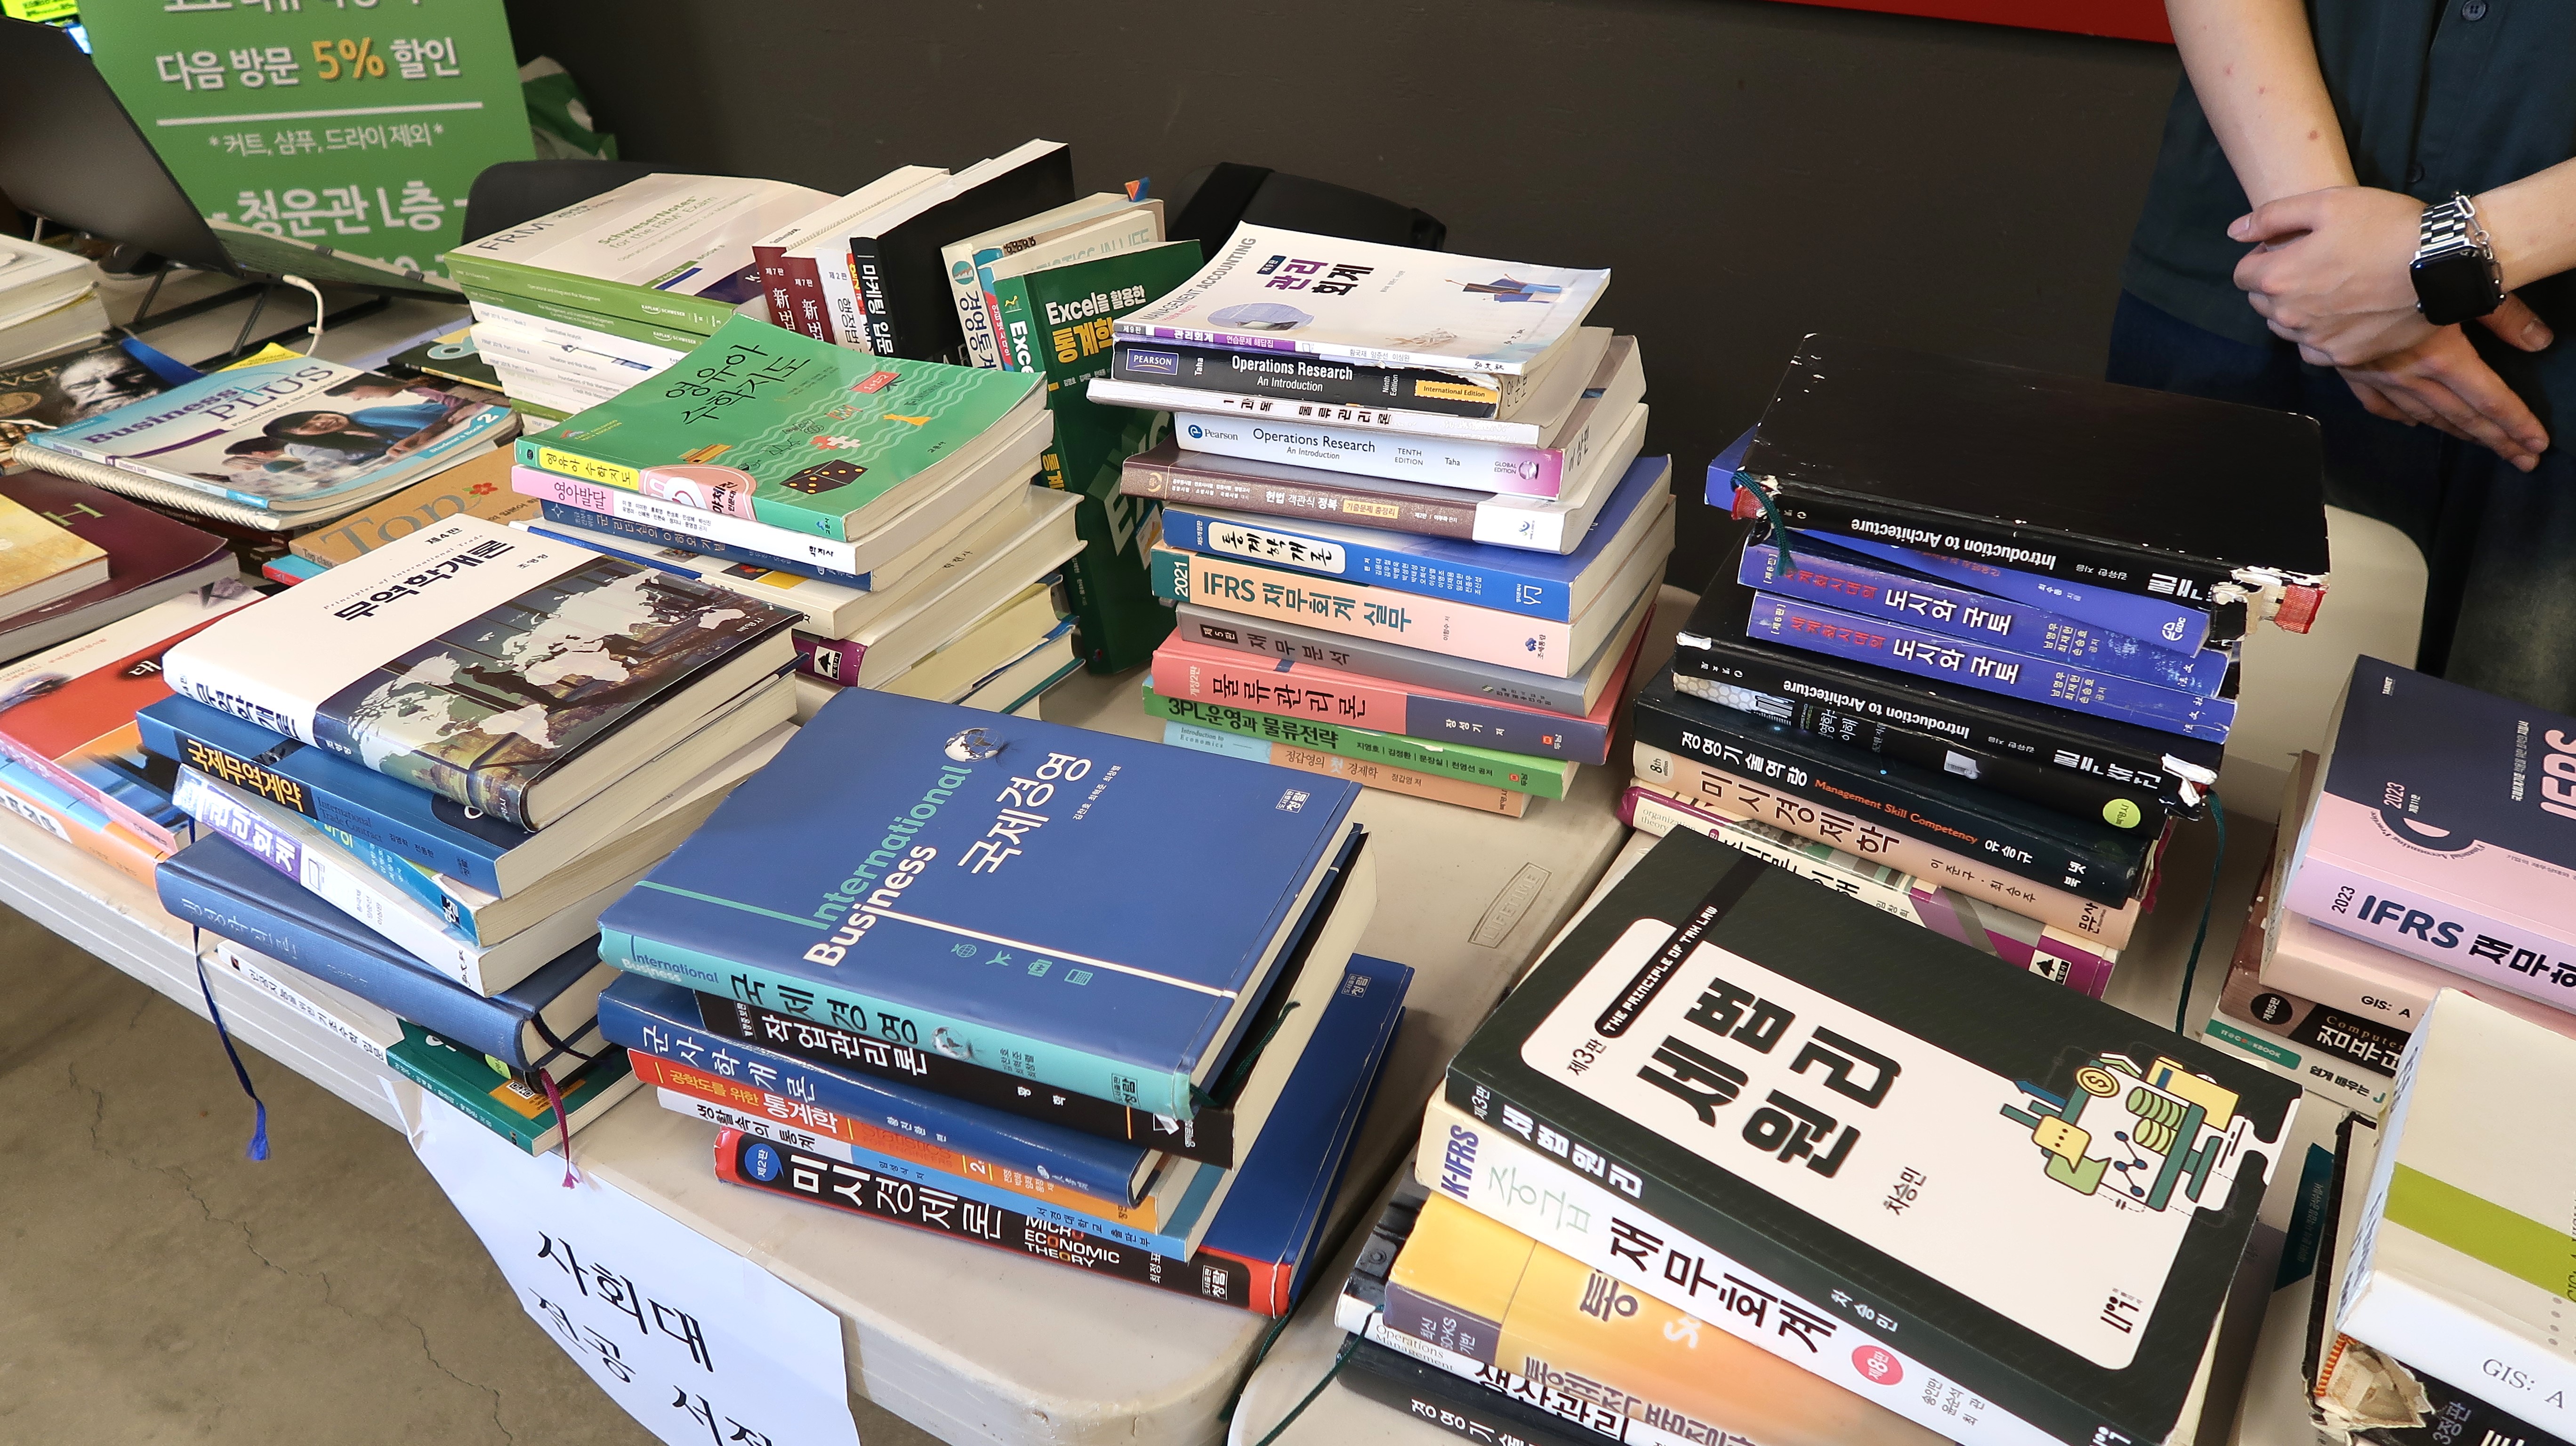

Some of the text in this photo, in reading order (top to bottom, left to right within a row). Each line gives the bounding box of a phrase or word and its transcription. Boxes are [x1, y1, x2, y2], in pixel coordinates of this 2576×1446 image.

[155, 37, 461, 91] 다음 방문 5% 할인
[223, 124, 388, 157] 커트, 드라이
[475, 221, 554, 252] FRM
[765, 267, 784, 276] 제7판
[795, 279, 813, 287] 제7판
[862, 264, 894, 355] 마케팅 입문
[1109, 285, 1147, 311] 활용한
[837, 298, 861, 344] 행정법
[1173, 329, 1214, 343] 관리회계
[665, 344, 769, 399] 영유아
[1133, 354, 1172, 366] PEARSON
[1231, 355, 1353, 381] Operations Research
[198, 366, 334, 422] PLUS
[681, 356, 812, 425] 수학지도
[1271, 377, 1323, 393] Introduction
[1423, 386, 1485, 397] International Edition
[81, 389, 238, 443] Business
[477, 414, 499, 424] 2
[1204, 428, 1239, 441] Pearson
[1253, 428, 1376, 453] Operations Research
[546, 453, 632, 486] 영유아 수학지도
[1298, 447, 1340, 460] Introduction
[1397, 448, 1422, 457] TENTH
[554, 481, 607, 511] 영아발달
[425, 527, 463, 545] 제4판
[1851, 518, 1942, 546] Architecture
[516, 554, 549, 570] 조영정
[809, 545, 834, 558] 학지사
[1964, 534, 2057, 570] Introduction
[322, 547, 455, 610] Principles International
[332, 539, 516, 621] 무역학개론
[1174, 561, 1189, 598] 2021
[1204, 571, 1356, 621] IFRS 재무회계
[1884, 588, 2013, 636] 도시와 국토
[2174, 617, 2187, 633] GDC
[1247, 633, 1351, 667] 재무분석
[2072, 630, 2088, 657] 손승호
[128, 660, 162, 676] 대
[1892, 638, 1966, 672] 도시와
[1969, 656, 2020, 685] 국토
[1212, 673, 1367, 720] 물류관리론
[2078, 678, 2095, 705] 손승호
[1168, 697, 1339, 750] 3PL운영과 물류전략
[1180, 726, 1217, 740] Introduction
[1885, 704, 1970, 740] Introduction
[1180, 735, 1224, 749] Economics
[1681, 730, 1808, 787] 경영기술역량
[186, 738, 304, 813] 국제무역계약
[1285, 749, 1379, 780] 정갑영의 경제학
[1649, 757, 1663, 774] 8th
[2053, 749, 2163, 790] 건축개론
[316, 795, 372, 827] International
[1700, 770, 1901, 854] 미시경제학
[1814, 779, 1882, 811] Management
[2383, 781, 2405, 810] 2023
[319, 808, 382, 843] Trade Contract
[958, 752, 1092, 875] 국제경영
[1640, 816, 1669, 833] theory
[791, 764, 973, 931] International
[1984, 839, 2033, 865] 유승규
[1930, 858, 2037, 903] 이준구 최승주
[803, 845, 937, 967] Business
[1482, 874, 1541, 940] LIFETIME
[1876, 899, 1909, 918] 임창희
[2078, 901, 2100, 934] 문우사
[2331, 884, 2464, 950] 2023 IFRS
[621, 957, 682, 983] Business
[631, 935, 719, 984] International
[1351, 976, 1368, 996] 청람
[1602, 957, 1673, 1034] THE PRINCIPLE
[731, 973, 919, 1044] 국제경영
[2262, 996, 2281, 1022] 개정5판
[2361, 995, 2411, 1019] GIS: A
[761, 1014, 928, 1076] 작업관리론
[1566, 1038, 1607, 1076] 제3판
[1636, 976, 1796, 1128] 세법
[643, 1024, 816, 1104] 군사학개론
[2310, 1065, 2370, 1097] 쉽게 배우는
[669, 1068, 839, 1133] 공학도를 위한 통계학
[1742, 1025, 1902, 1179] 원리
[696, 1104, 816, 1151] 생활속의 통계
[1441, 1124, 1480, 1200] K-IFRS
[790, 1154, 1002, 1240] 미시경제론
[1883, 1166, 1927, 1216] 차승민
[1036, 1206, 1151, 1247] 서경대학교 출판부
[1472, 1085, 1899, 1333] 제3판 세법원리 차승민
[1024, 1230, 1120, 1265] ECONOMIC
[1024, 1241, 1095, 1268] THEORY
[1212, 1269, 1225, 1297] 청람
[1488, 1165, 1890, 1380] 중급 재무회계 제8판
[537, 1230, 715, 1374] 사회대
[527, 1286, 636, 1385] 전공
[1376, 1324, 1445, 1359] Operations
[1419, 1317, 1437, 1341] 최신
[1375, 1333, 1454, 1372] Management
[1921, 1376, 1943, 1407] 송인만
[1941, 1386, 1964, 1416] 윤순석
[2482, 1358, 2566, 1410] GIS: A
[1474, 1365, 1630, 1443] 생산관리
